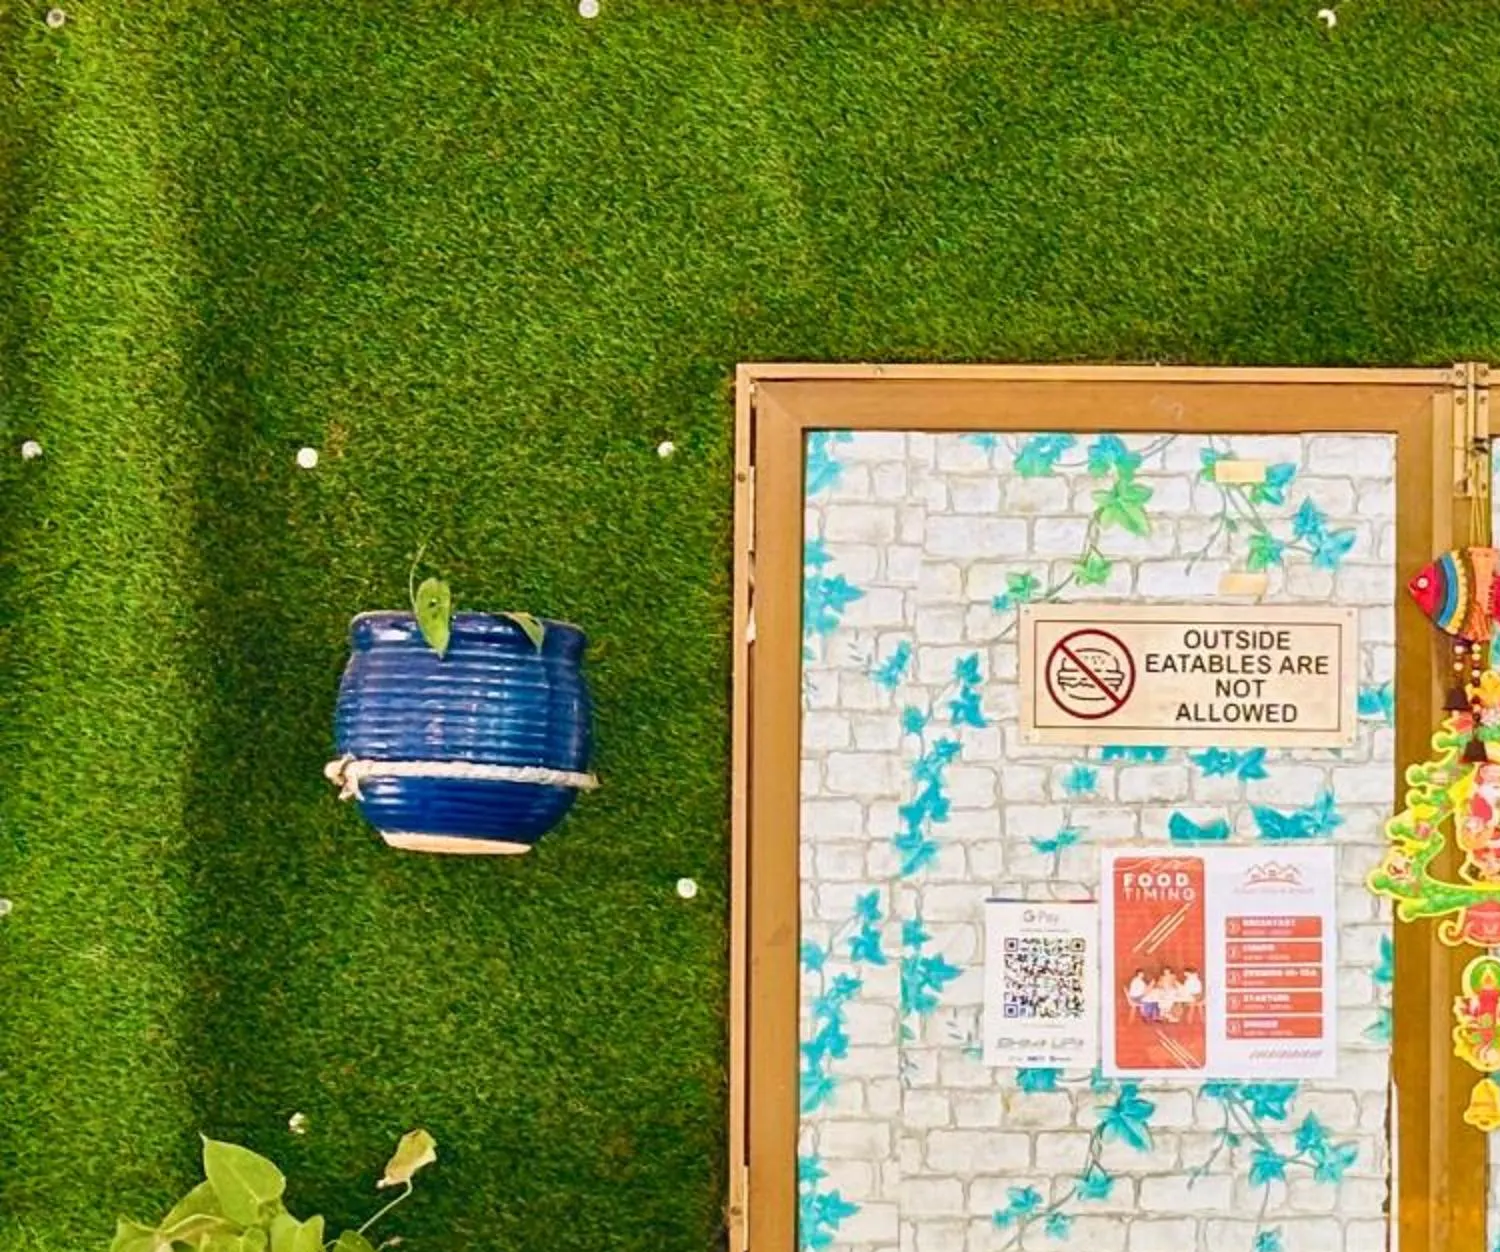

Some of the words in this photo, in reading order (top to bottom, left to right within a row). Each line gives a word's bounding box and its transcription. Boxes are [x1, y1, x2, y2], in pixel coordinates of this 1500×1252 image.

[1183, 629, 1291, 650] OUTSIDE
[1145, 653, 1271, 675] EATABLES
[1279, 655, 1329, 675] ARE
[1215, 679, 1266, 699] NOT
[1175, 703, 1298, 723] ALLOWED
[1123, 872, 1189, 888] FOOD
[1123, 887, 1196, 901] TIMING
